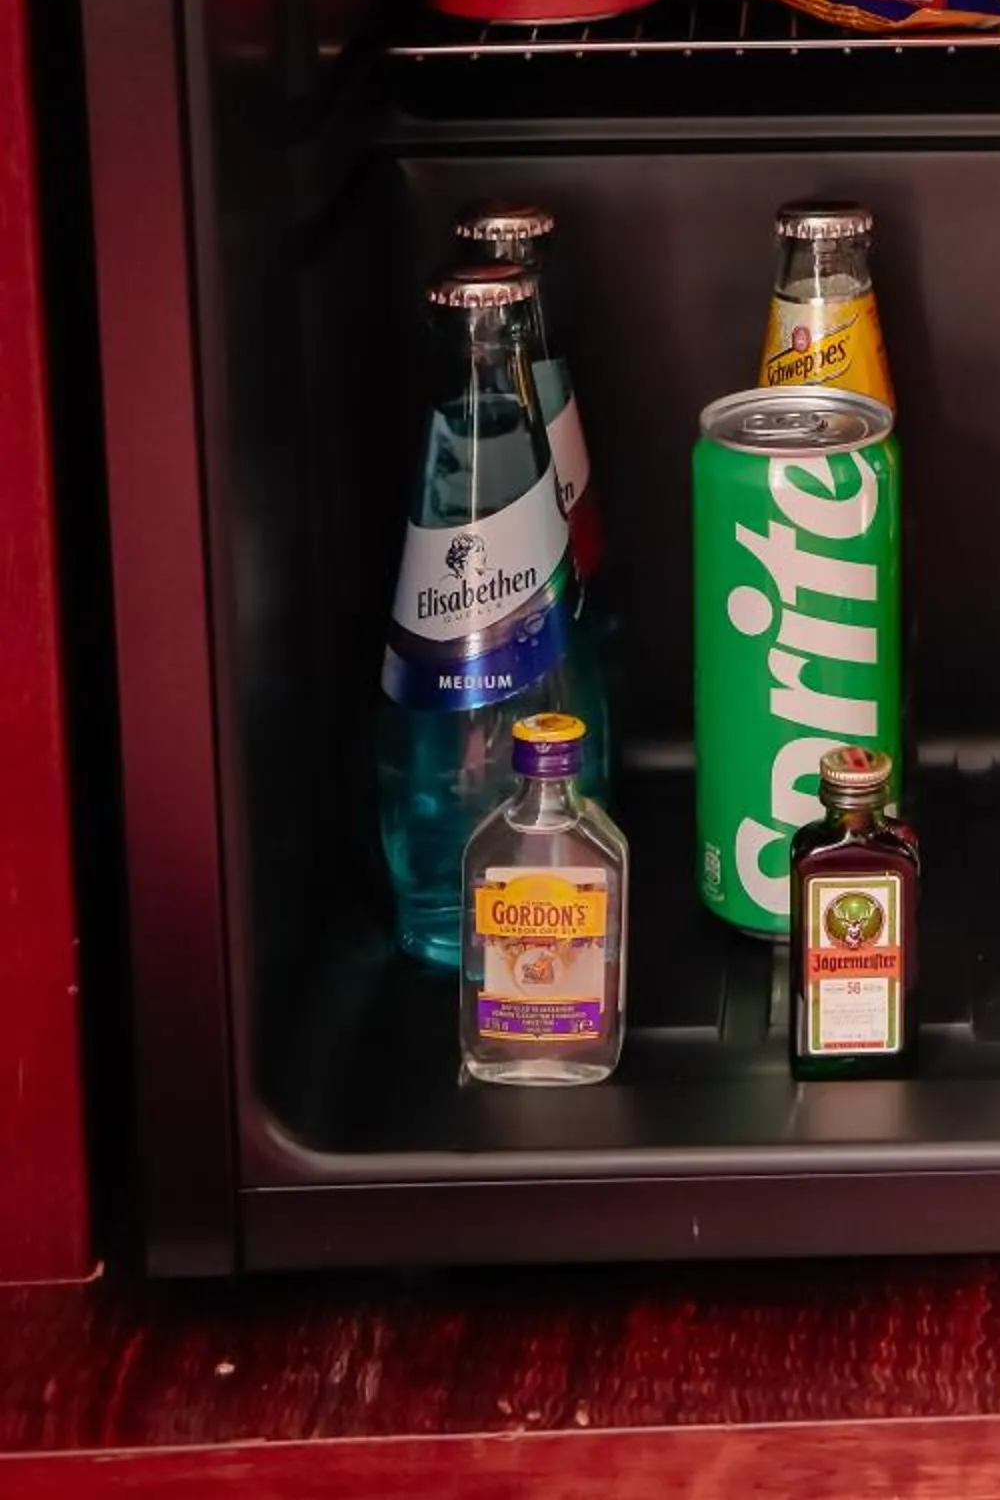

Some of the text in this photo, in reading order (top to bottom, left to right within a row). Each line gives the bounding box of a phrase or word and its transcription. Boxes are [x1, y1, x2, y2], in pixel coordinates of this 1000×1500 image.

[417, 566, 538, 620] Elisabethen
[438, 674, 513, 690] MEDIUM
[491, 901, 586, 927] GORDON'S
[812, 953, 897, 972] Jägermeister
